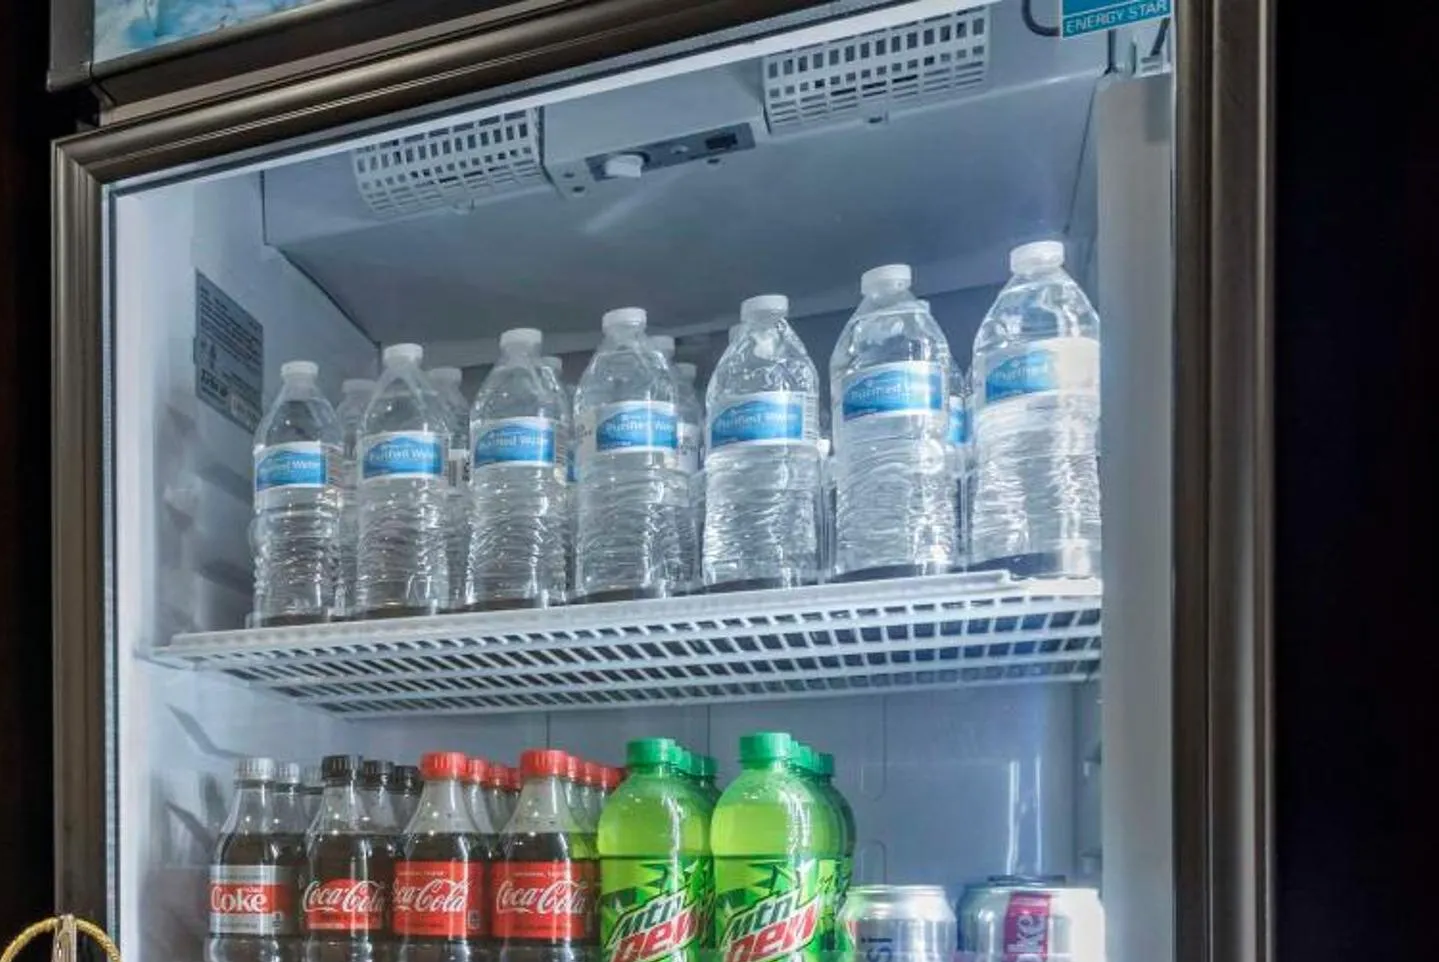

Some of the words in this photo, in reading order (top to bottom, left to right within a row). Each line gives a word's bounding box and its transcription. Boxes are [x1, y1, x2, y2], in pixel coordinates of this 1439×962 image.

[1065, 10, 1125, 34] ENERGY
[1128, 2, 1168, 20] STAR
[211, 886, 269, 914] Coke
[302, 878, 386, 913] Coca-Cola
[496, 879, 587, 914] Coca-Cola
